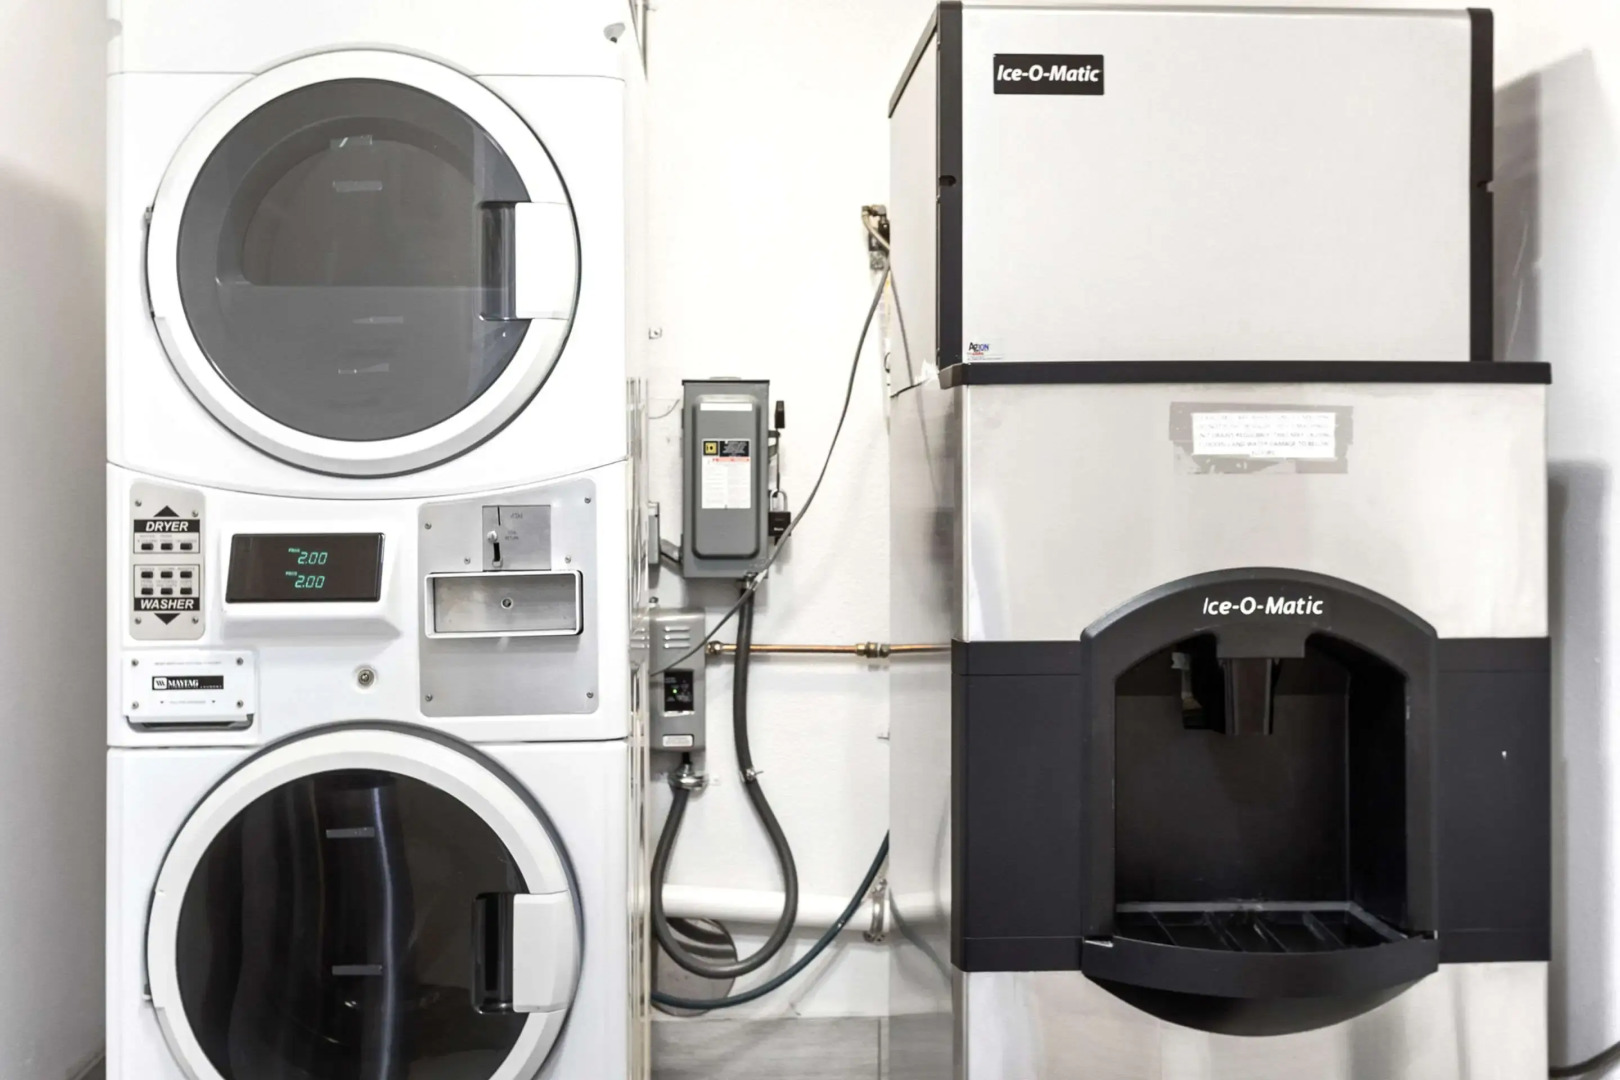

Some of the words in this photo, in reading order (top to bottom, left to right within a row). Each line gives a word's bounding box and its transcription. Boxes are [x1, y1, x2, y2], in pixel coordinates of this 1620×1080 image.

[997, 64, 1100, 82] Ice-O-Matic
[145, 521, 189, 532] DRYER
[297, 551, 328, 565] 2.00
[294, 575, 326, 588] 2.00
[140, 599, 194, 609] WASHER
[1203, 595, 1324, 615] Ice-O-Matic
[168, 679, 199, 689] MAYTAG
